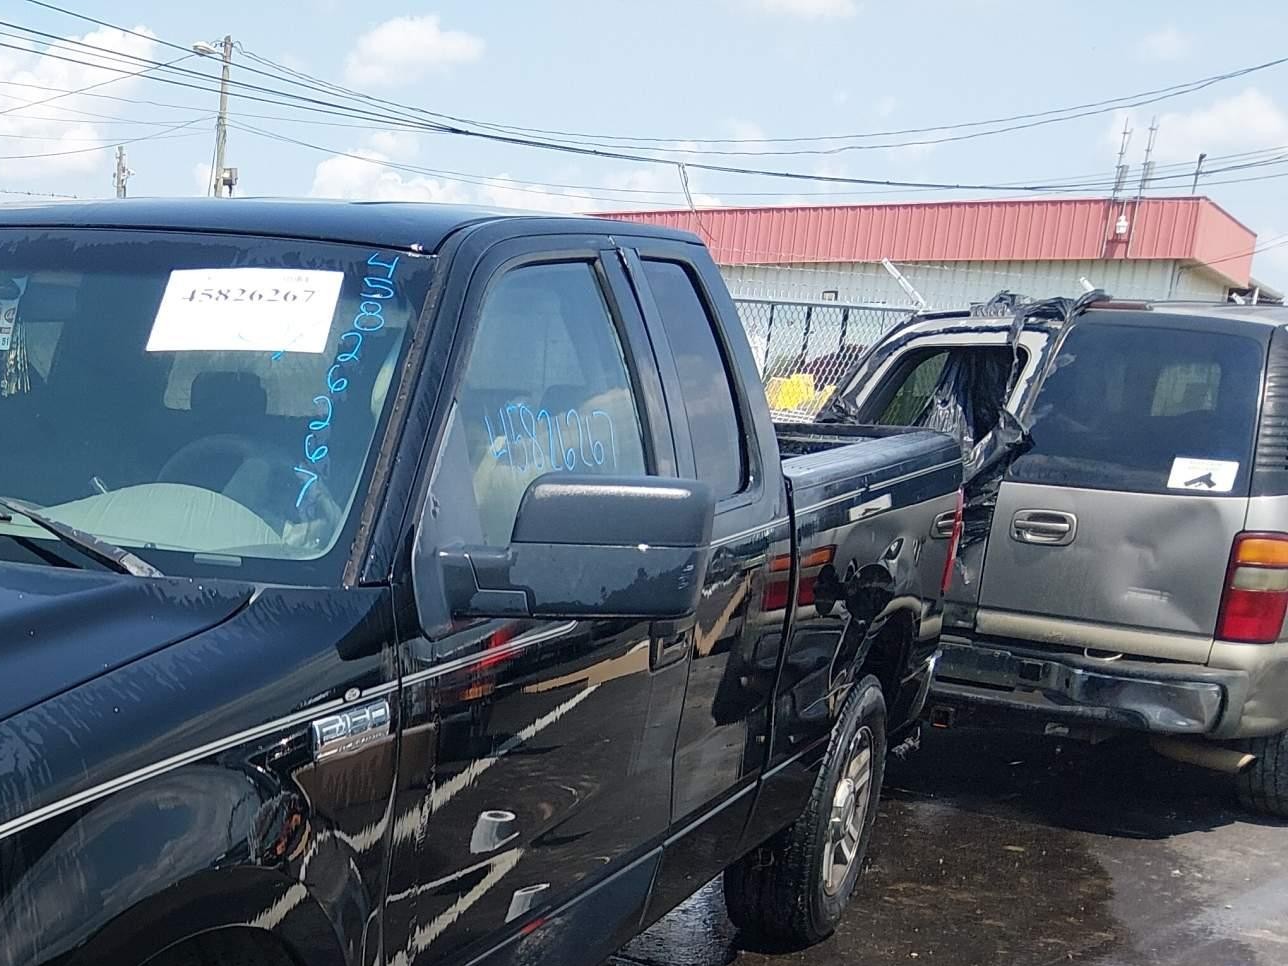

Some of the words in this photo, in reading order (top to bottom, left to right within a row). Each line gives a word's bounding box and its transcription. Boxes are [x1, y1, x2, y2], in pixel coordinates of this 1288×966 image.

[182, 287, 317, 303] 45826267
[293, 253, 399, 507] 45826267
[484, 400, 617, 472] 45826267
